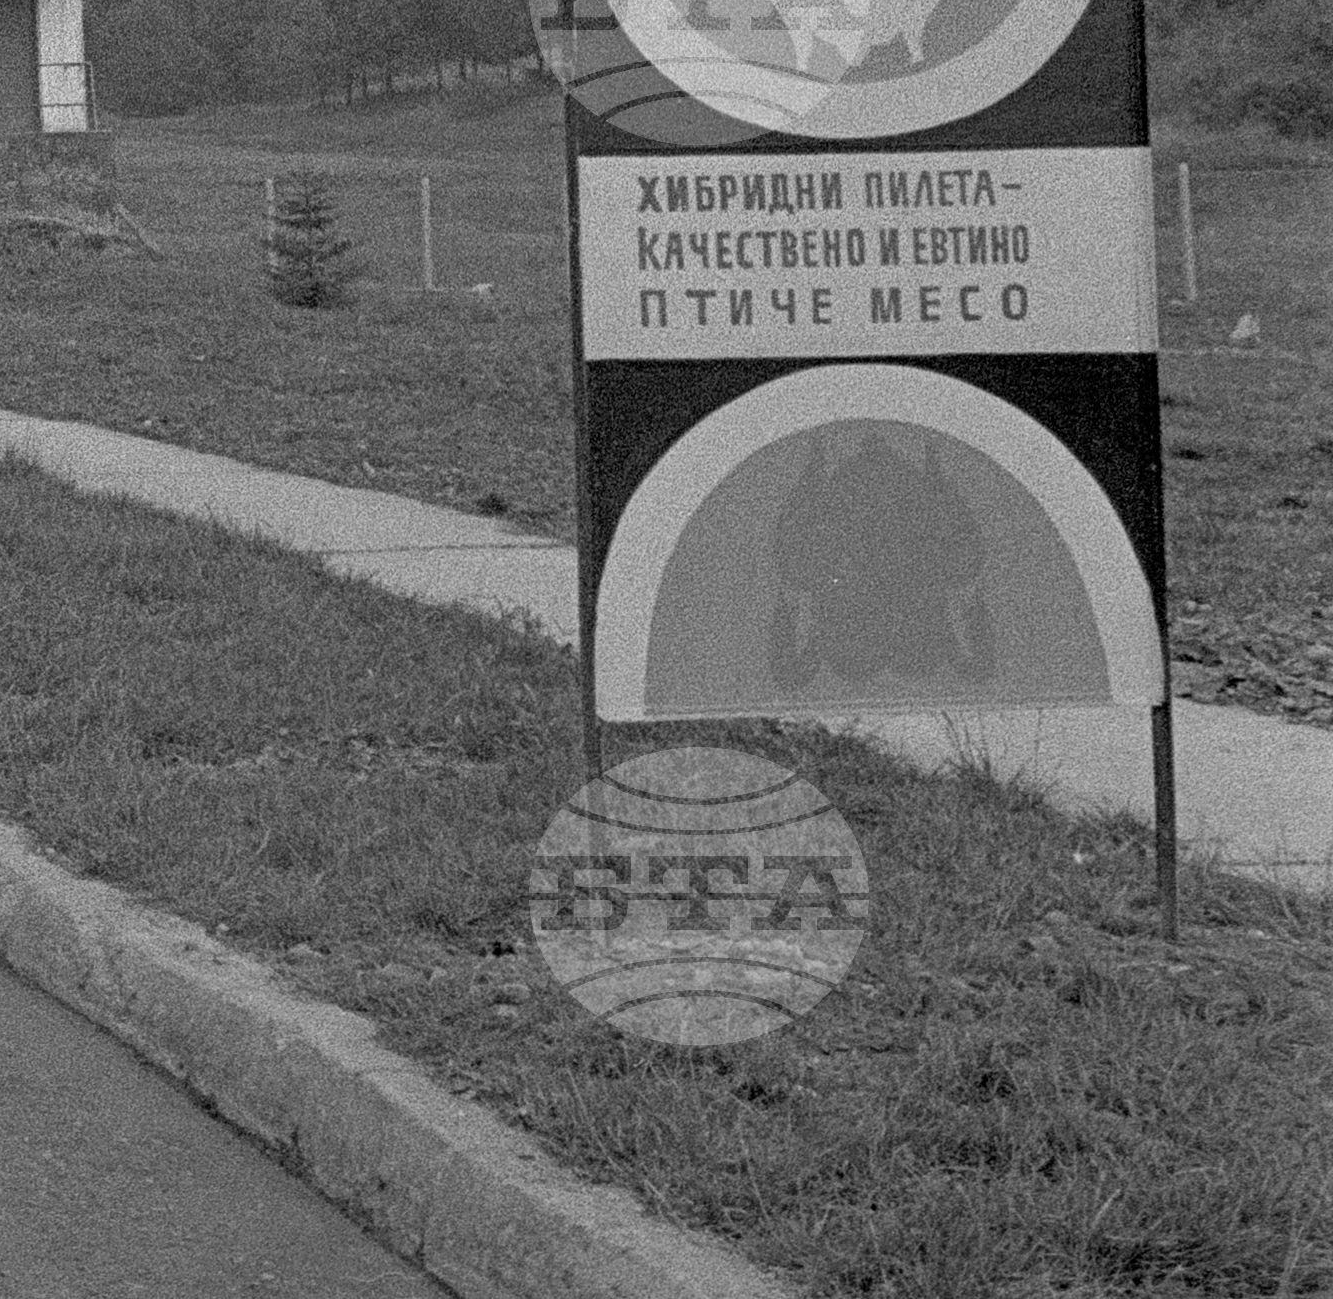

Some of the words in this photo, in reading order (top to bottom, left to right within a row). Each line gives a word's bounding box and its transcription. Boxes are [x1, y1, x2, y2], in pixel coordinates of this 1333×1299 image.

[637, 173, 843, 215] ХИБРИДНИ
[637, 226, 866, 271] КАЧЕСТВЕНО
[879, 227, 901, 267] И
[912, 225, 1031, 266] ЕВТИНО
[639, 288, 834, 328] ПТИЧЕ
[869, 283, 1030, 324] МЕСО
